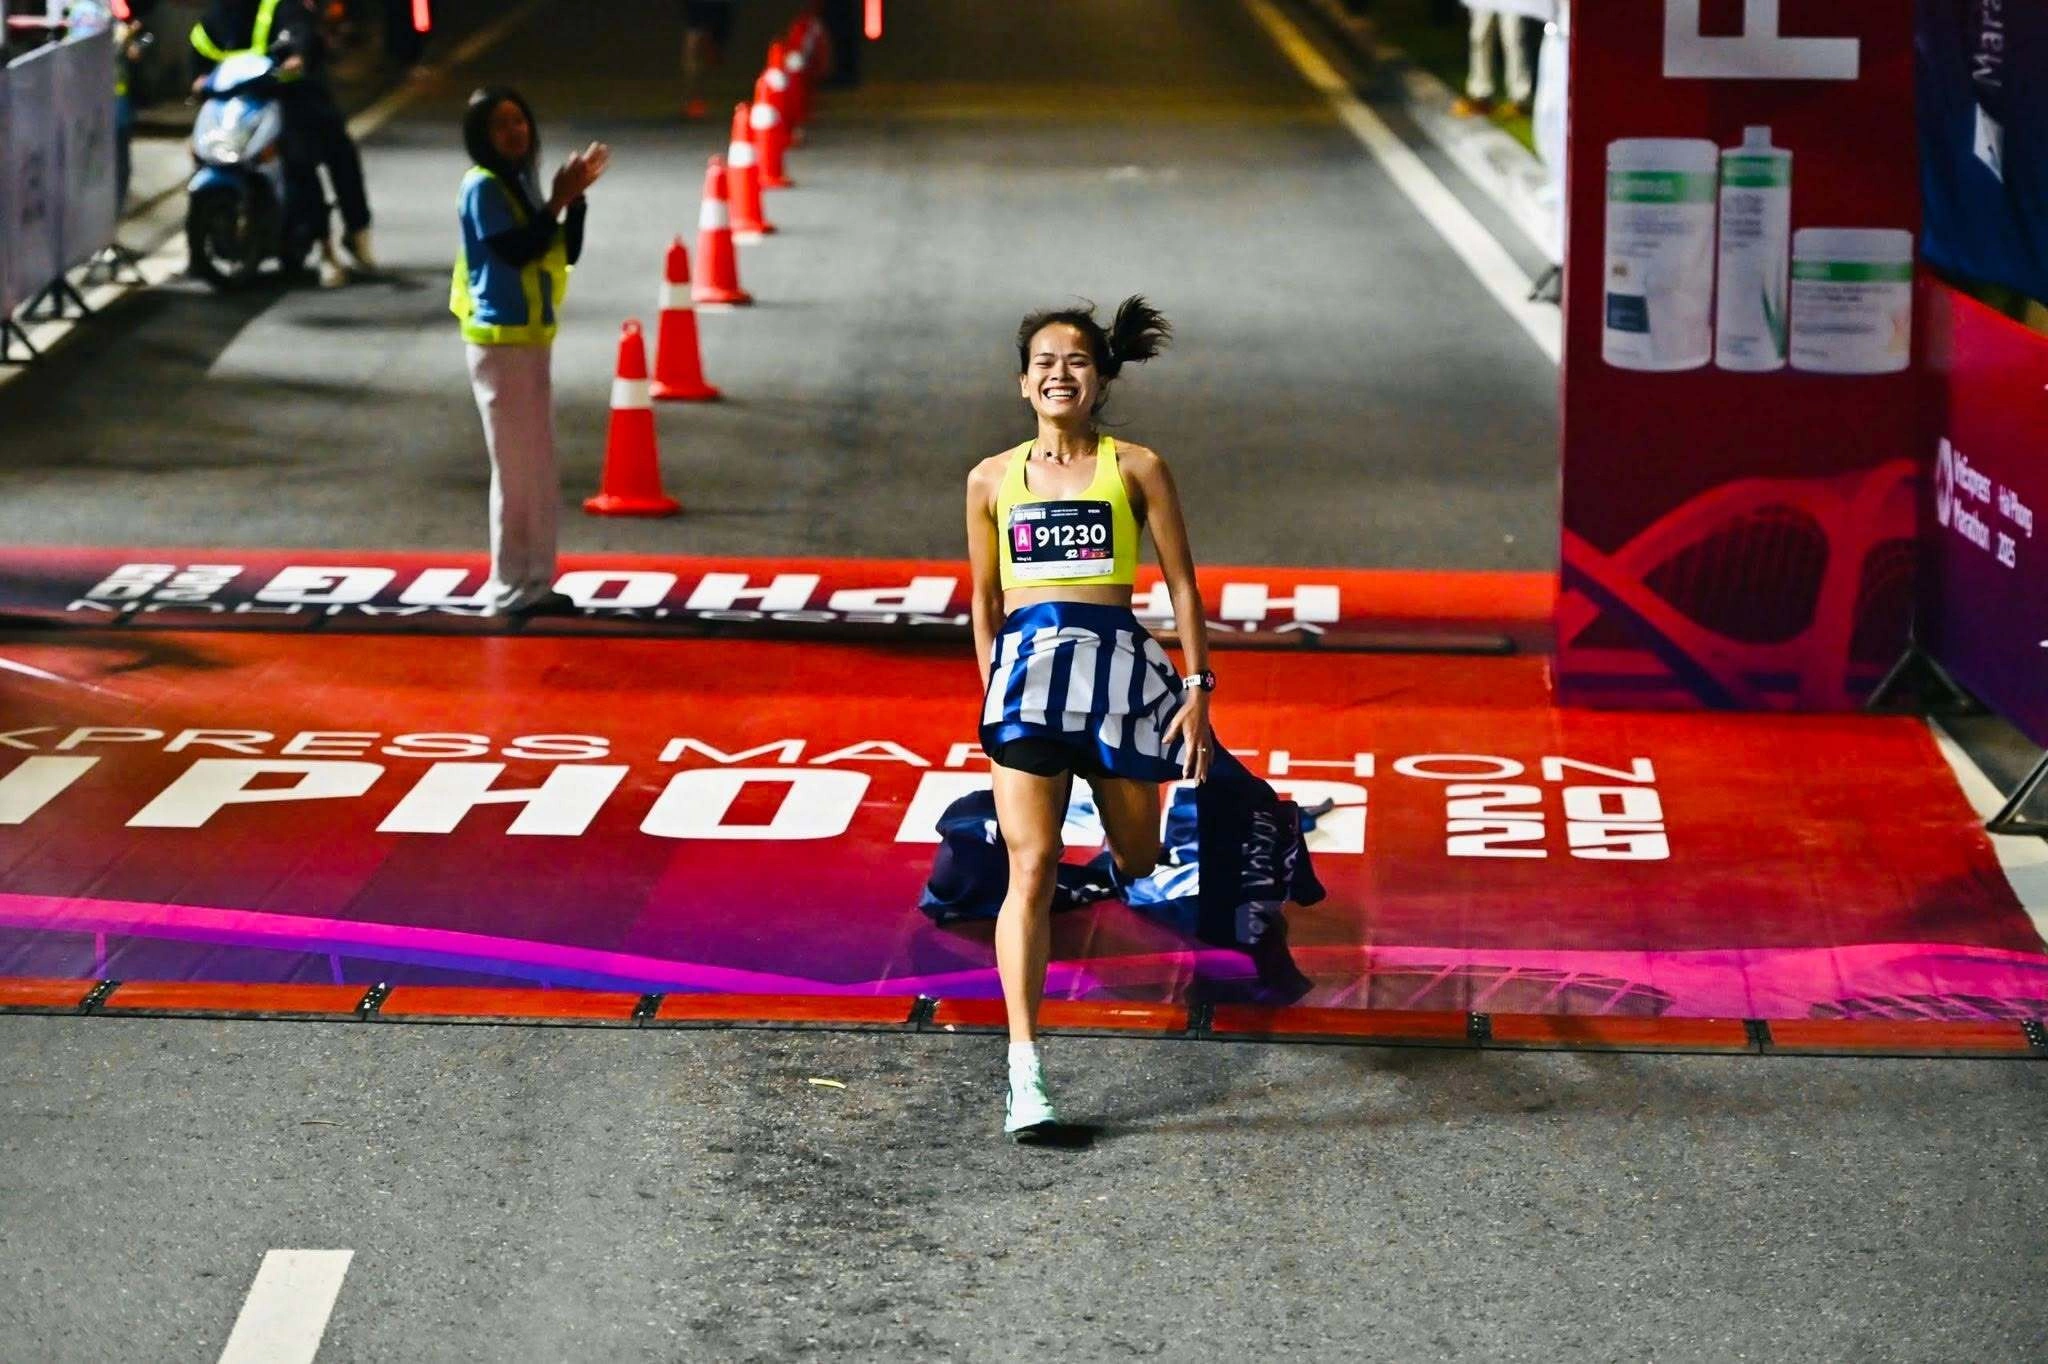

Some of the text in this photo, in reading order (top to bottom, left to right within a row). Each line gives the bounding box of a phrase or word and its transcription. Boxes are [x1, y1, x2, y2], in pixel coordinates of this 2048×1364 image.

[1017, 523, 1107, 548] A 91230
[657, 737, 1656, 783] MAHON
